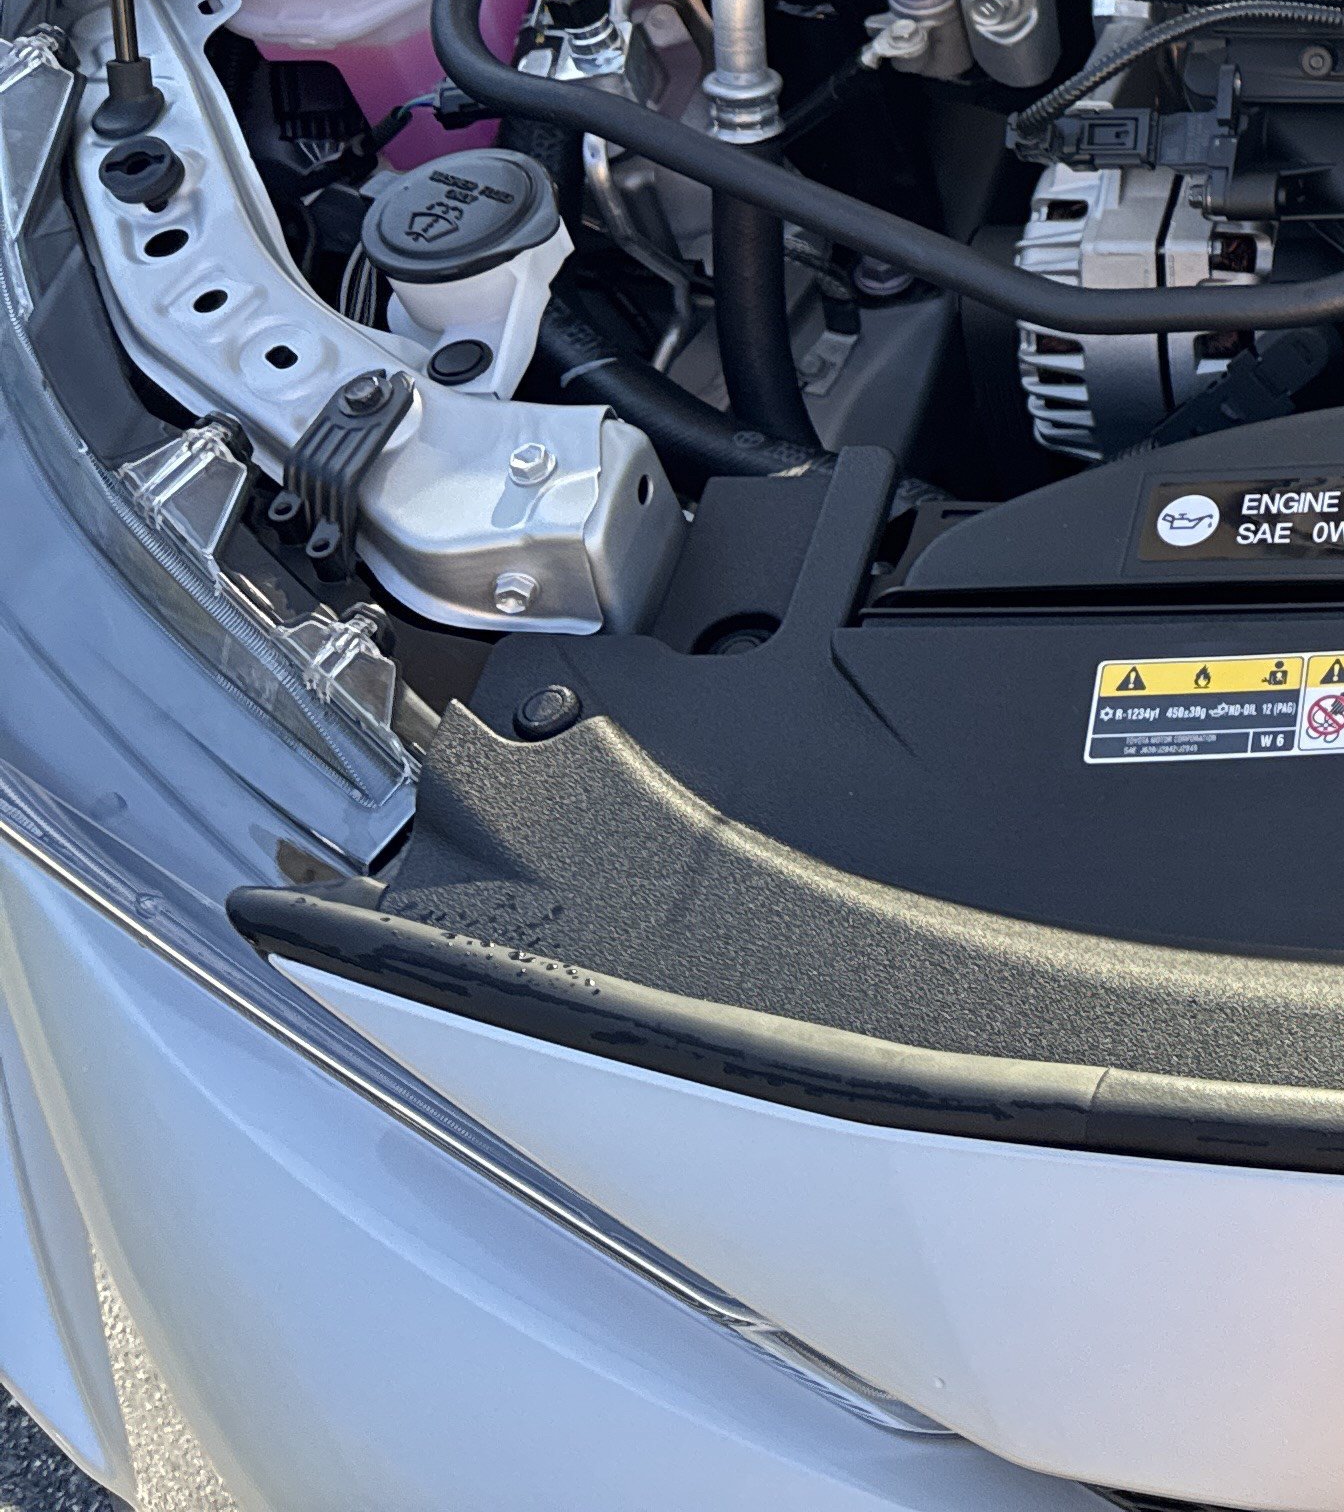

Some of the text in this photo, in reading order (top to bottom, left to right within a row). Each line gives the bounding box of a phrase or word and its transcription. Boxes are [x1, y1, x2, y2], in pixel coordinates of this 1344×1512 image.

[1241, 491, 1341, 515] ENGINE
[1236, 522, 1293, 545] SAE
[1115, 707, 1160, 721] R-1234yf
[1262, 702, 1273, 715] 12
[1273, 701, 1296, 716] (PAG)
[1261, 733, 1285, 747] W 6
